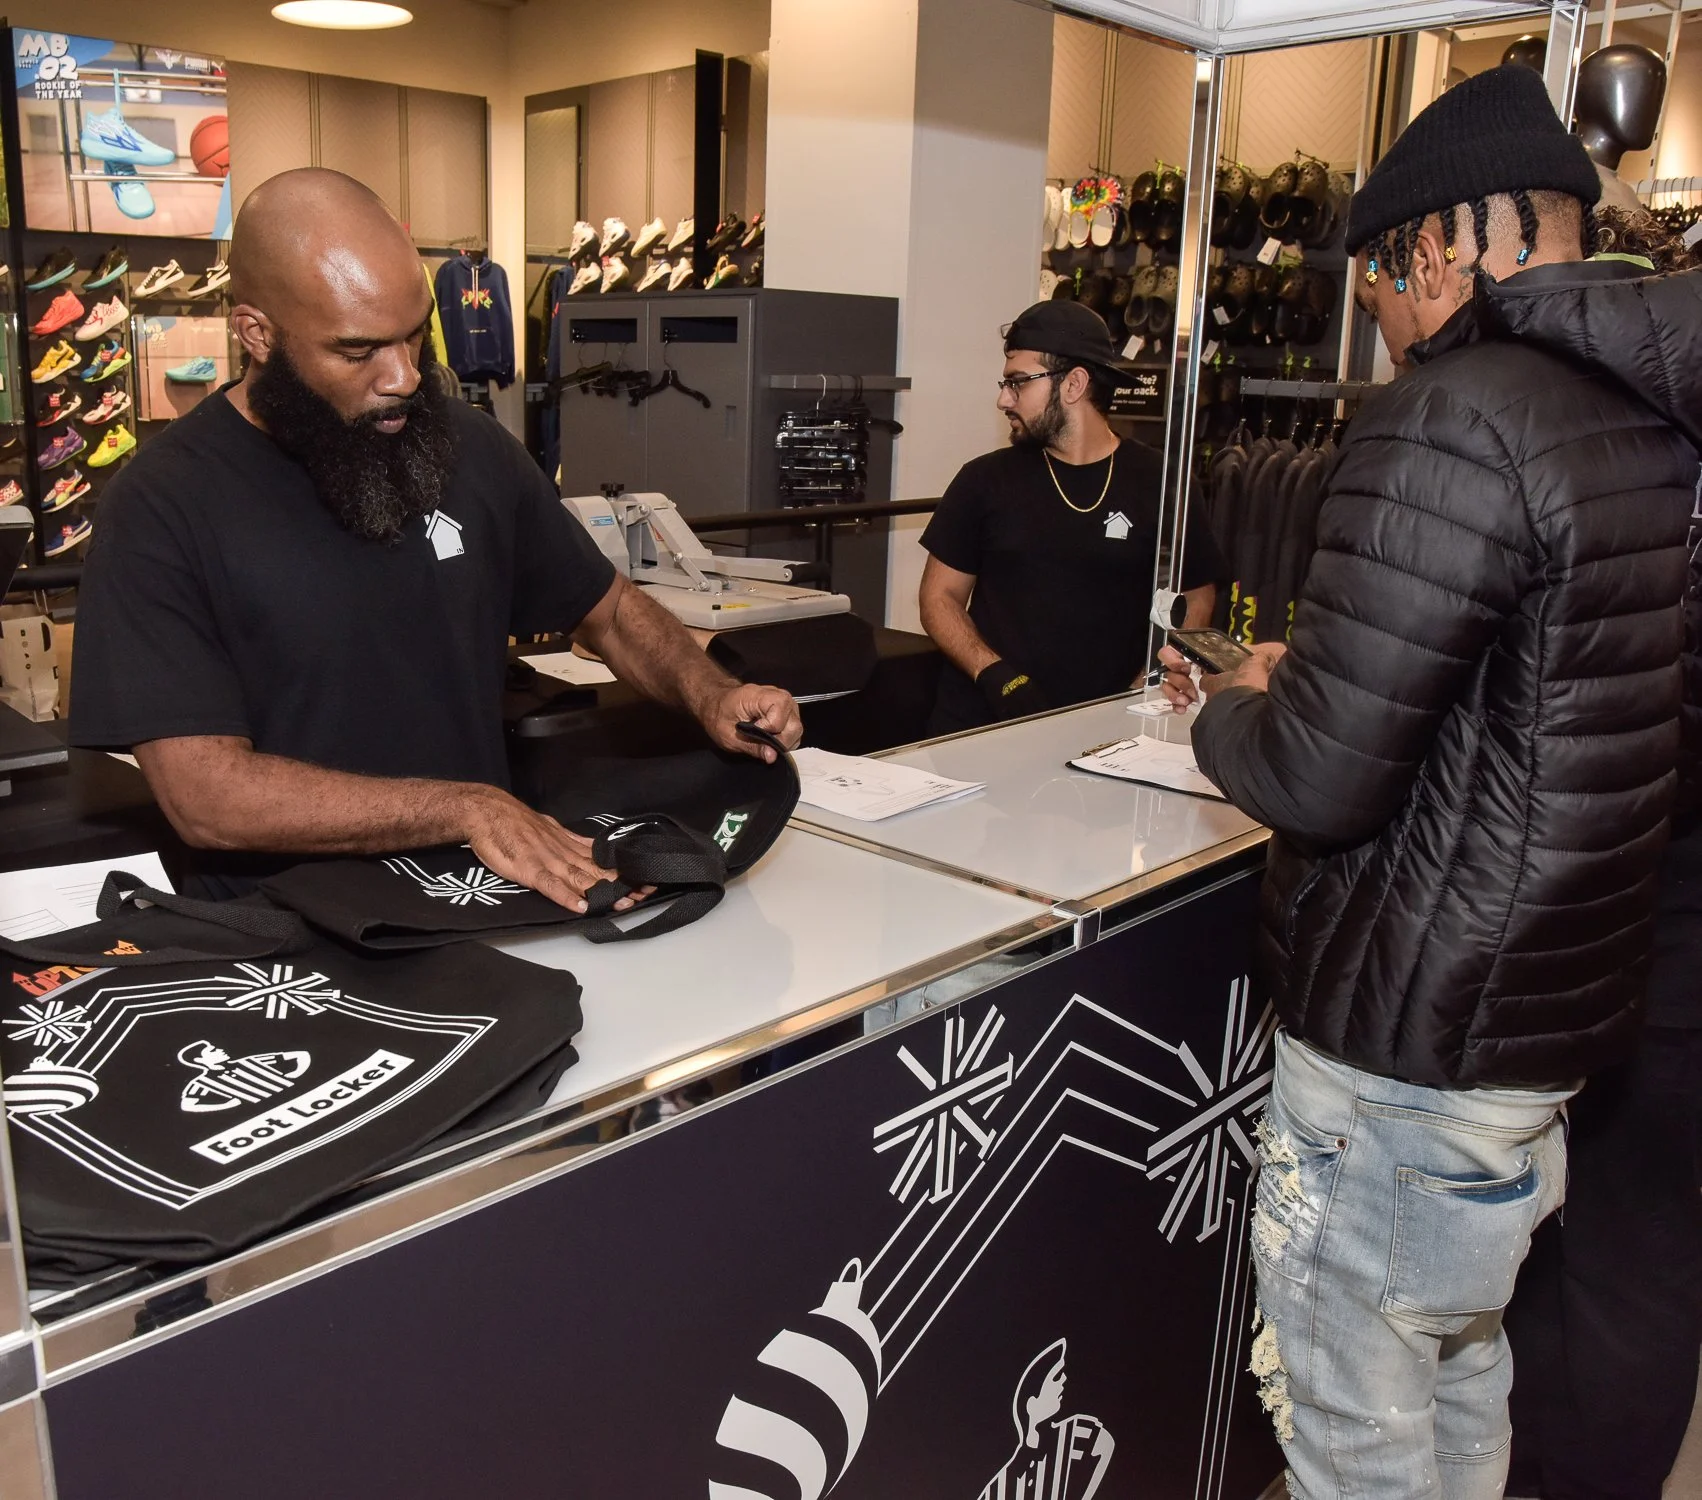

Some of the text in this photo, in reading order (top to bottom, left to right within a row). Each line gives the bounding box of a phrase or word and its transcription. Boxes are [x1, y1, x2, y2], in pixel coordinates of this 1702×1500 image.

[18, 33, 69, 58] MB
[34, 81, 81, 90] ROOKIE OF
[35, 90, 83, 100] THE YEAR
[207, 1059, 397, 1157] Foot Locker
